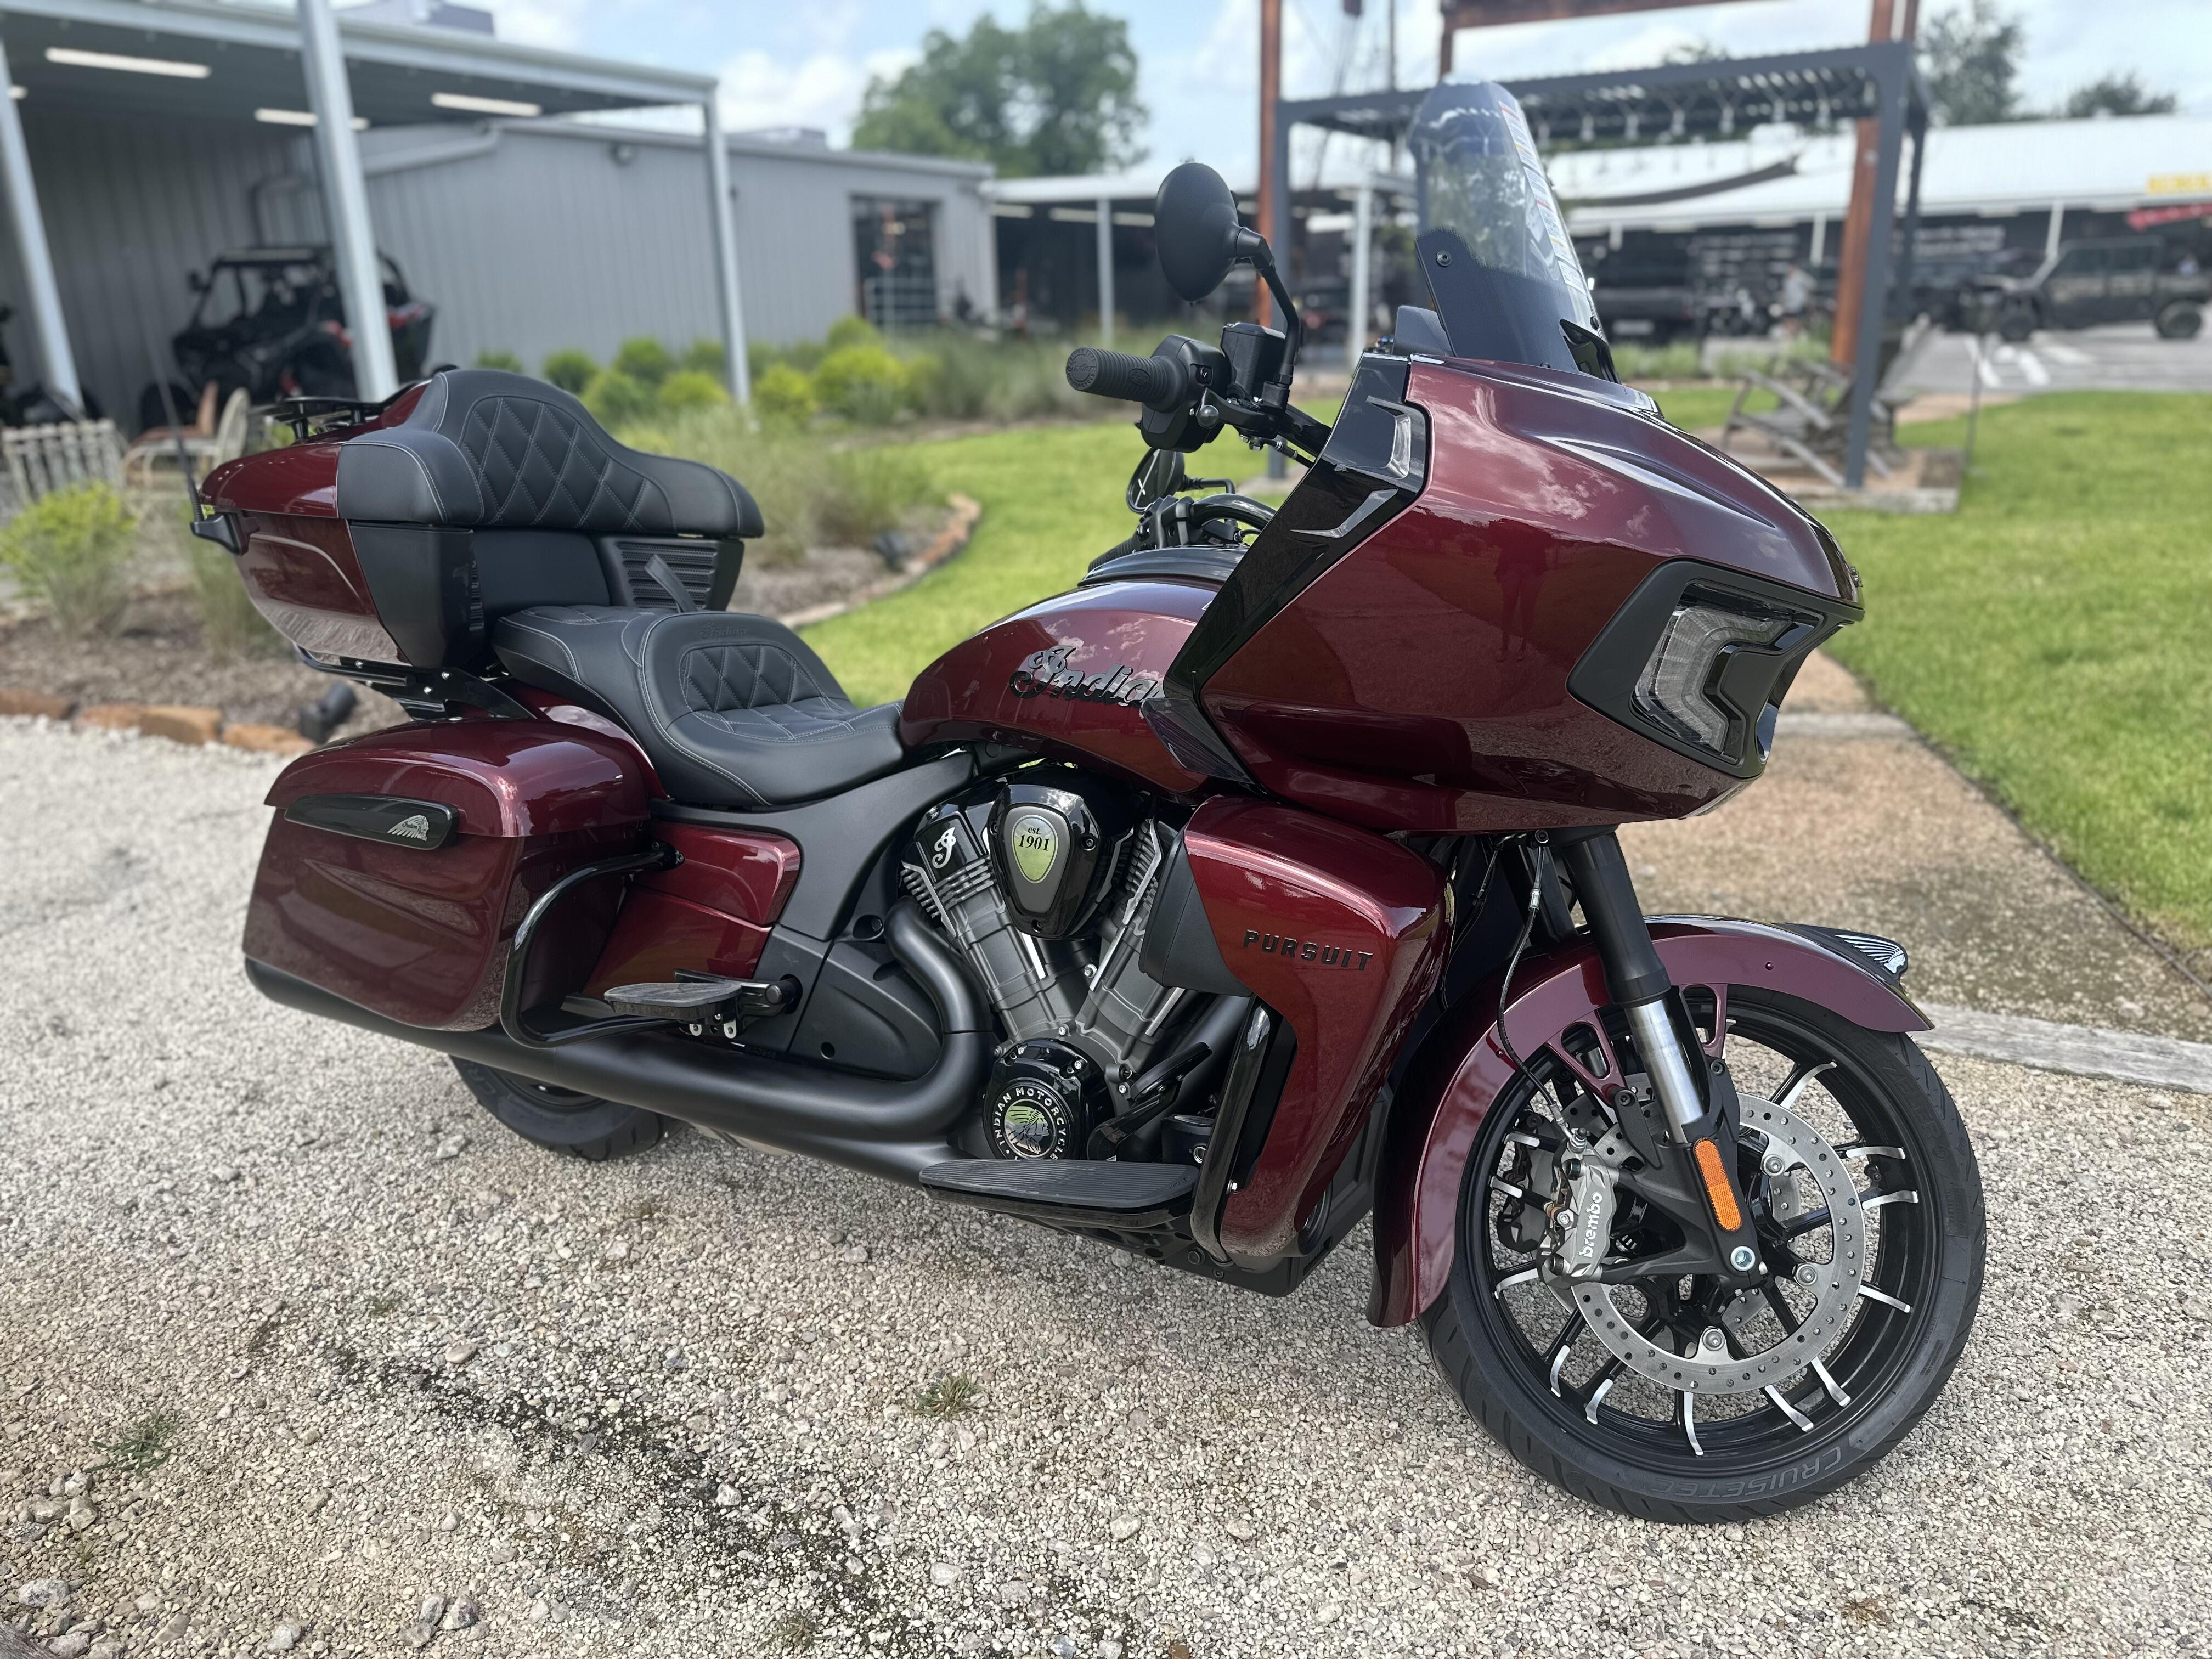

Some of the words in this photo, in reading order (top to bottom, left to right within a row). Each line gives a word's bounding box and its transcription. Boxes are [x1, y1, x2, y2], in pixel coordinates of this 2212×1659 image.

[1018, 834, 1050, 851] 1901
[1243, 929, 1373, 970] PURSUIT
[994, 1092, 1012, 1146] INDIAN
[1015, 1087, 1066, 1160] MOTORCYCLE
[1578, 1192, 1602, 1258] brembo
[1650, 1446, 1841, 1498] CRUISETEC
